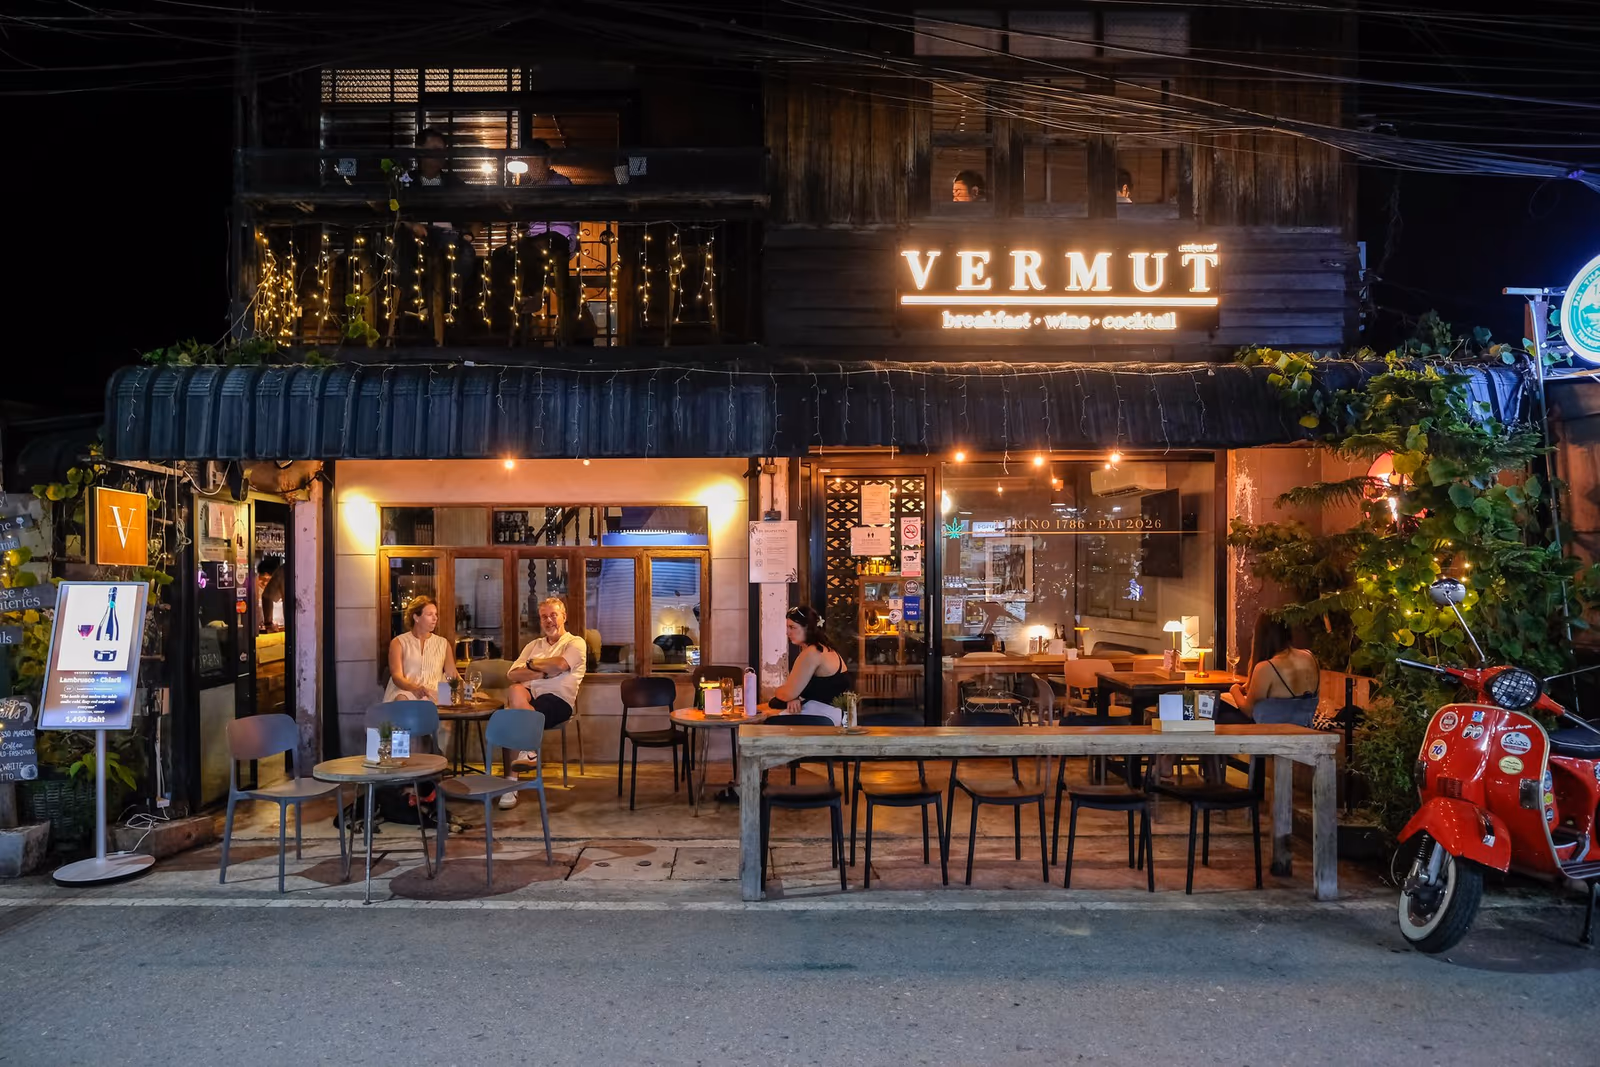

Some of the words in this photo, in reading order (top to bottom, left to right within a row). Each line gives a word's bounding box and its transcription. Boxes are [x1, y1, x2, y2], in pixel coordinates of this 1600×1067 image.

[901, 249, 1218, 293] VERMUT
[1573, 291, 1583, 306] PAI
[942, 310, 1031, 329] breakfast
[1043, 312, 1091, 330] wine
[1102, 311, 1177, 330] cocktail
[109, 505, 137, 549] V
[1056, 519, 1085, 530] 1786
[1098, 519, 1121, 530] PAI
[1126, 519, 1162, 530] 2026
[65, 715, 86, 723] 1,490
[87, 715, 106, 723] Baht
[1431, 744, 1443, 755] 76
